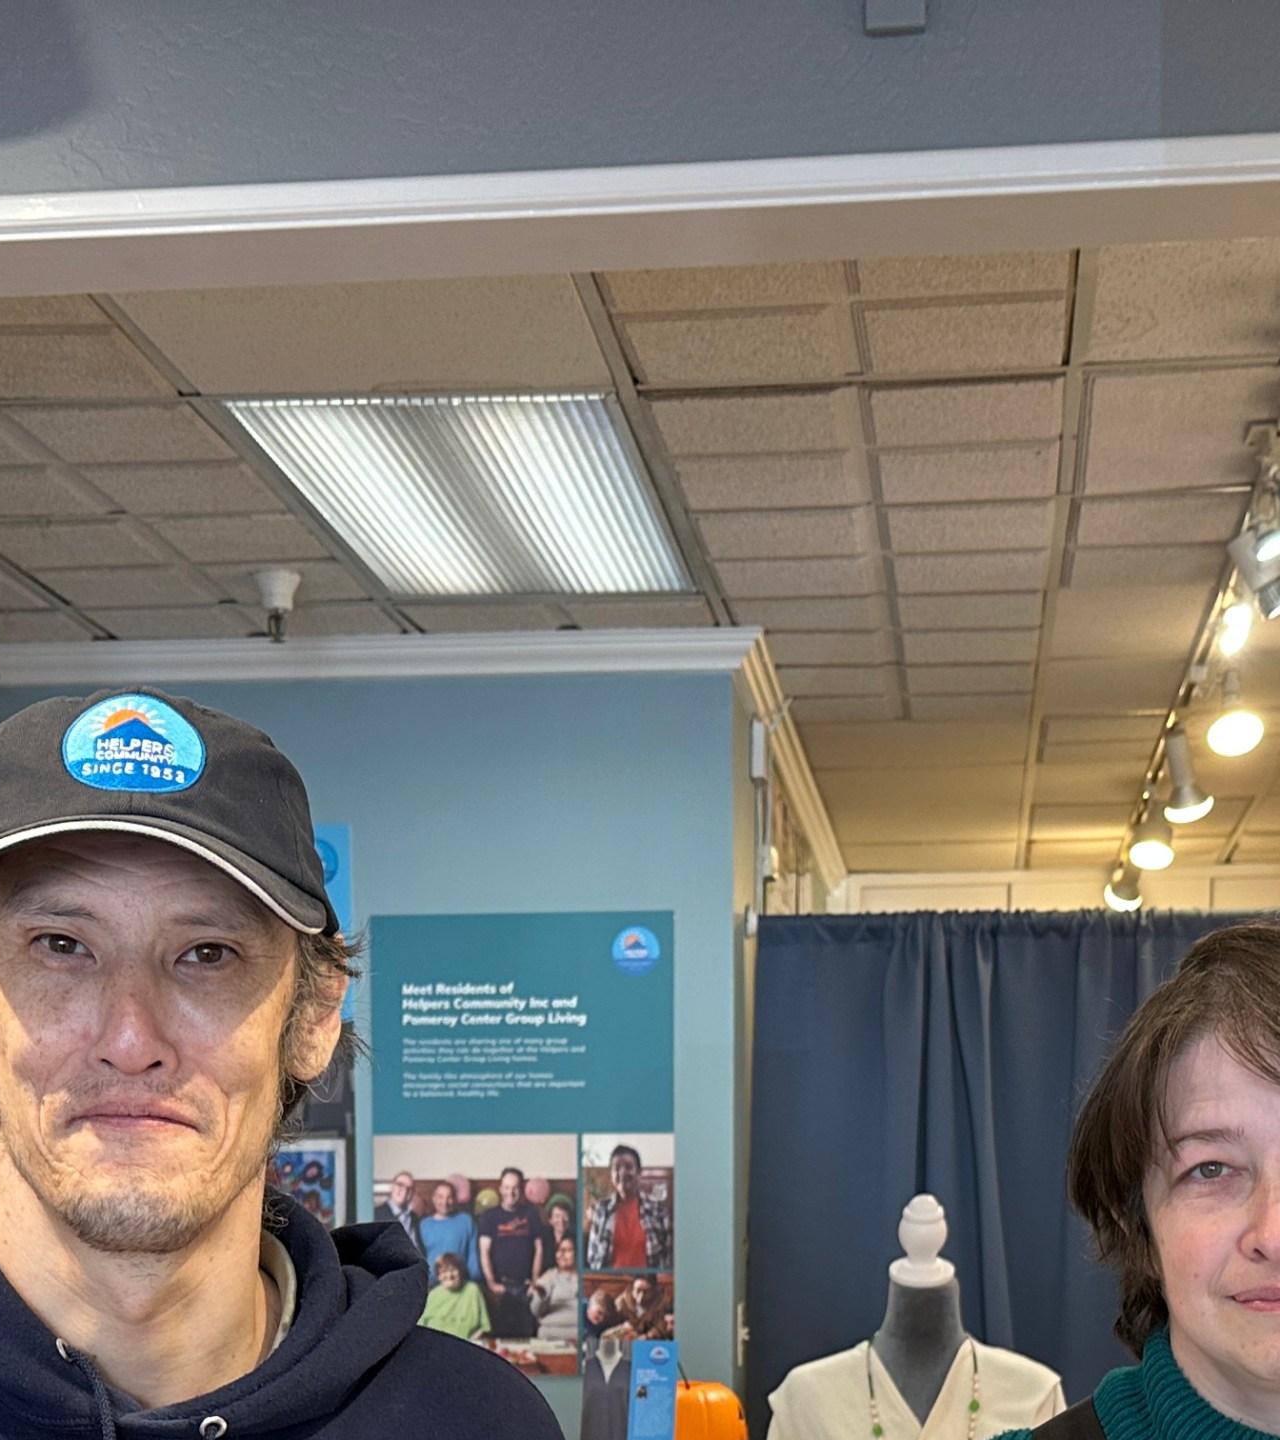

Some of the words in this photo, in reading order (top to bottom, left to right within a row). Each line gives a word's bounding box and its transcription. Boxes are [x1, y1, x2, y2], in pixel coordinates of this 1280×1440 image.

[97, 738, 175, 758] HELPERS
[95, 750, 174, 765] COMMUNITY
[82, 762, 135, 776] SINCE
[402, 983, 433, 995] Meet
[435, 983, 496, 995] Residents
[499, 982, 514, 995] of
[402, 998, 450, 1012] Helpers
[453, 998, 527, 1011] Community
[529, 997, 548, 1009] Inc
[552, 995, 578, 1009] and
[402, 1014, 458, 1027] Pomeroy
[461, 1013, 502, 1025] Center
[505, 1013, 545, 1027] Group
[548, 1012, 587, 1027] Living
[546, 1038, 567, 1046] group
